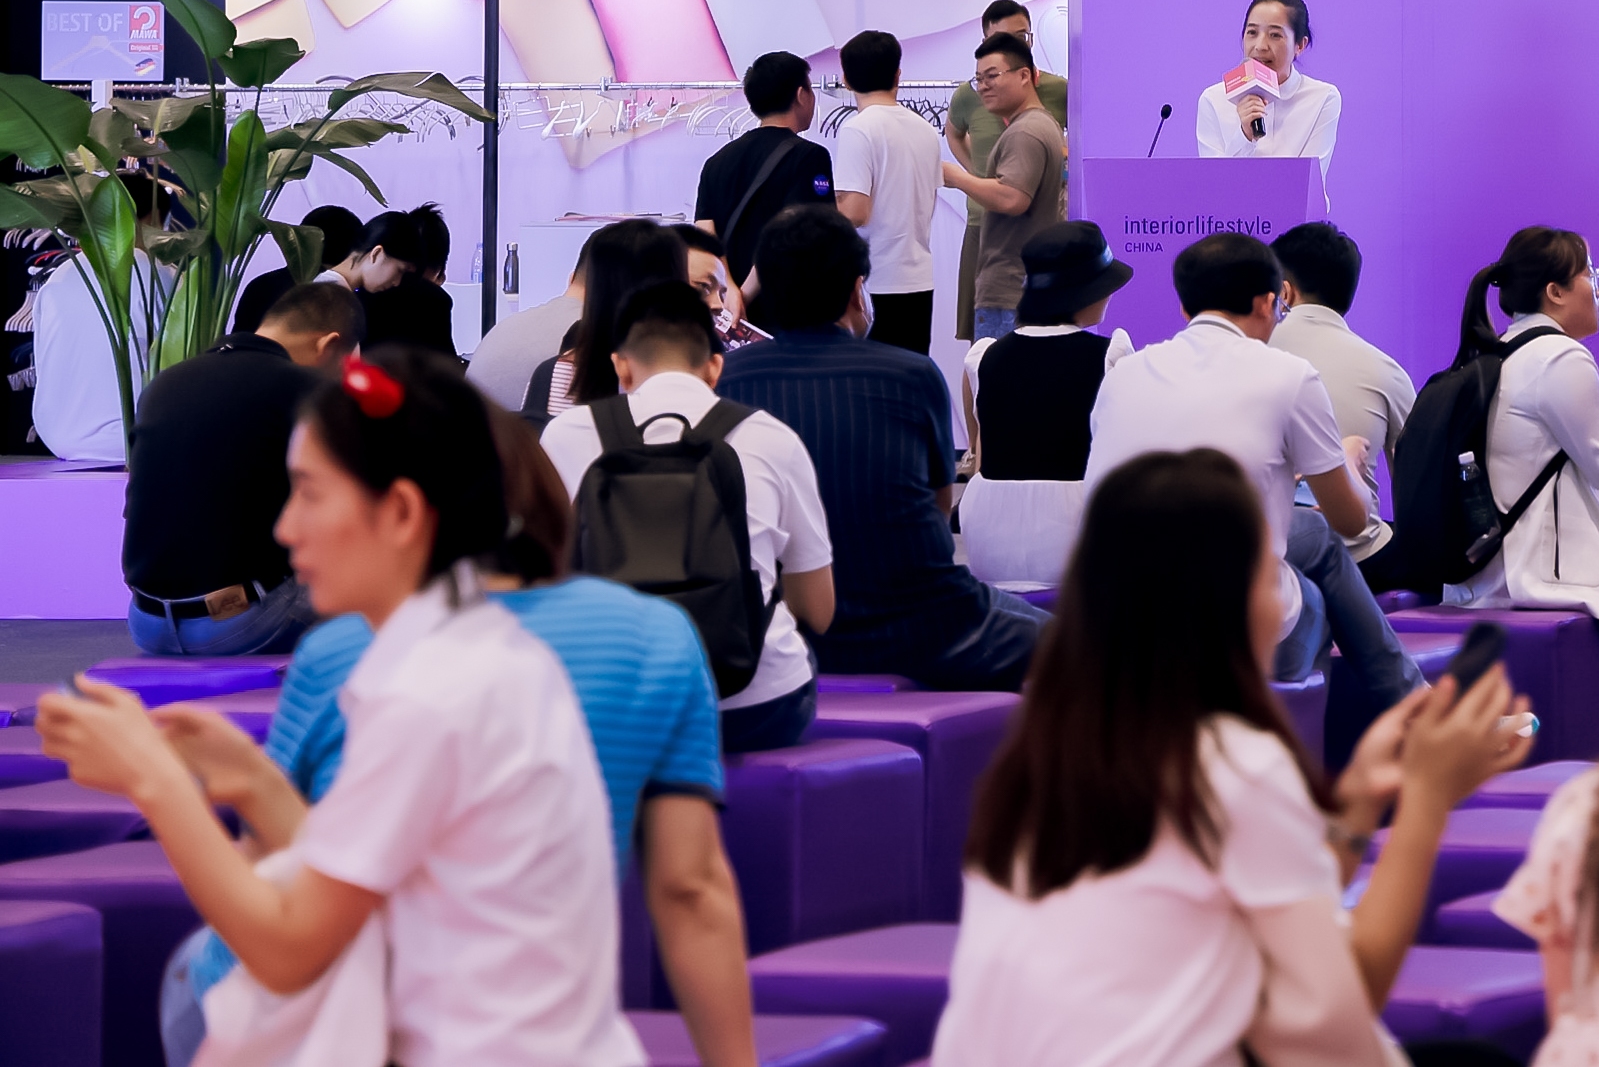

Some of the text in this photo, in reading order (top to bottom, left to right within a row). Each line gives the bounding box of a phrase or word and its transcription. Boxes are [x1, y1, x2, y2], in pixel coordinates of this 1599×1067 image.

[46, 12, 123, 32] BEST OF
[129, 29, 159, 39] MAWA
[1124, 215, 1272, 235] interiorlifestyle
[1124, 242, 1164, 253] CHINA
